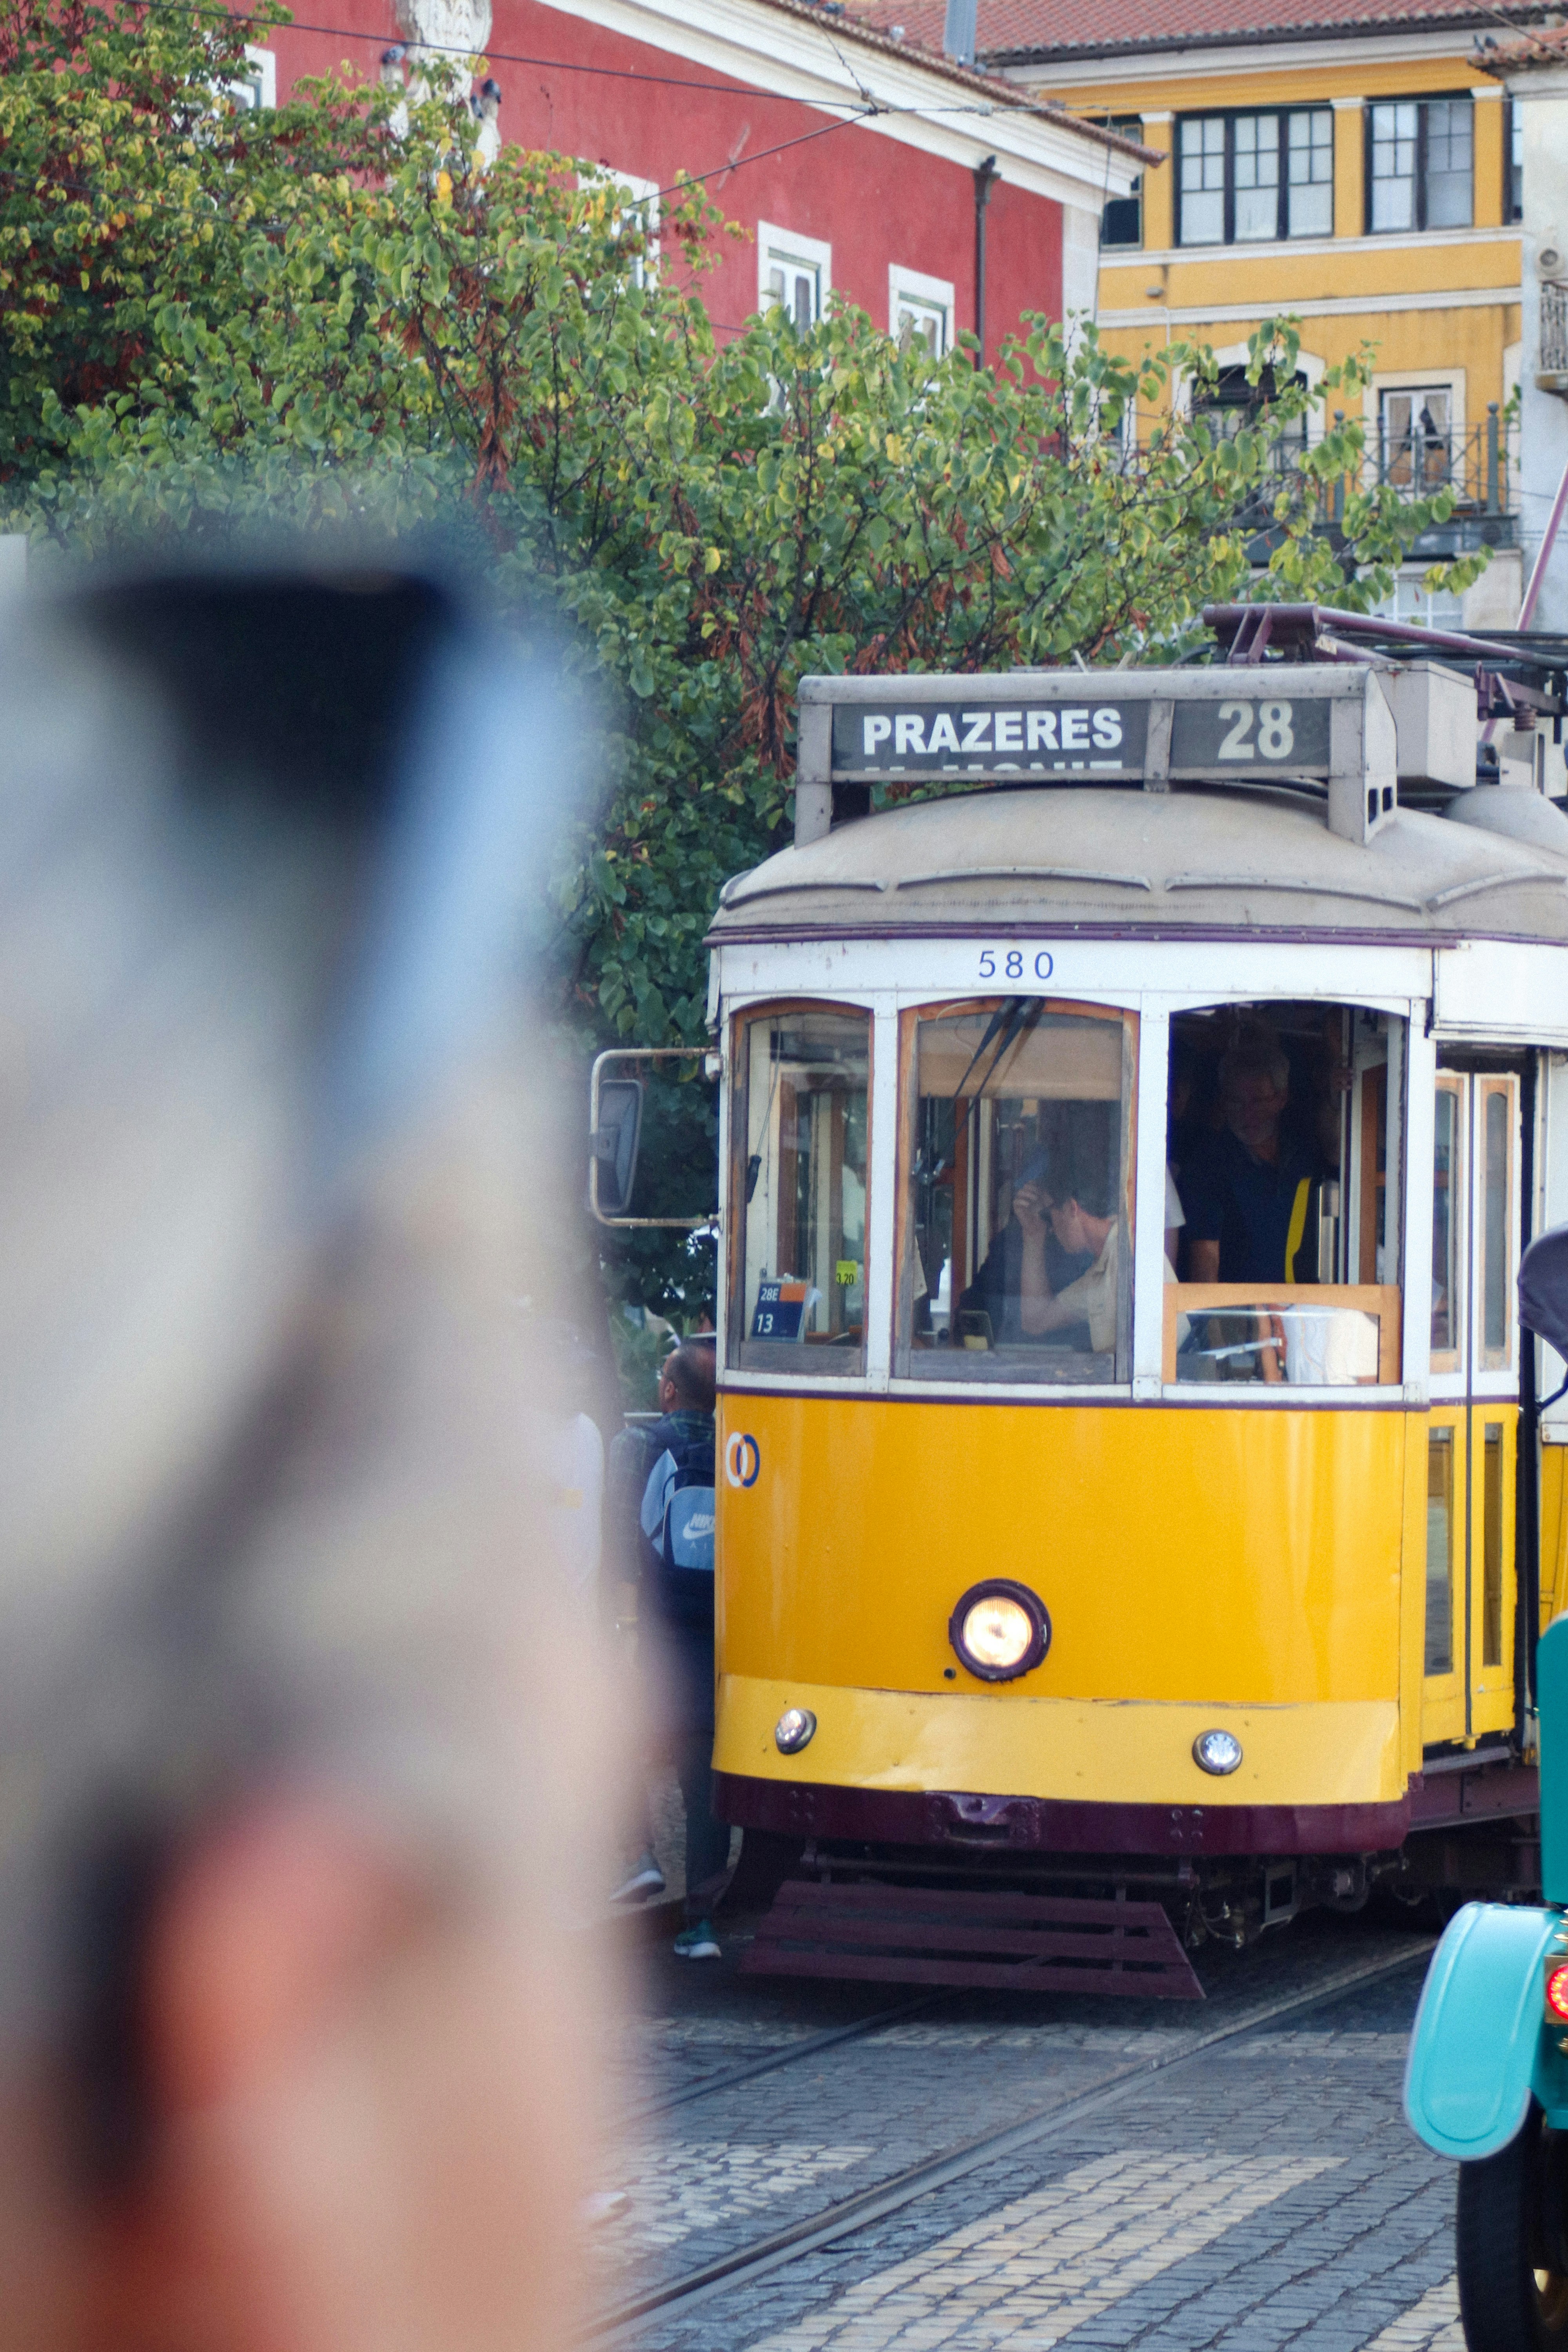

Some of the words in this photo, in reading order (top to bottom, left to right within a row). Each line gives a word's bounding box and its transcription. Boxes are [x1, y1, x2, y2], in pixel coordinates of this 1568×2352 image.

[863, 708, 1123, 755] PRAZERES
[1218, 700, 1294, 759] 28
[979, 950, 1054, 979] 580
[760, 1287, 779, 1301] 28E
[757, 1314, 773, 1333] 13
[690, 1513, 715, 1529] NIK
